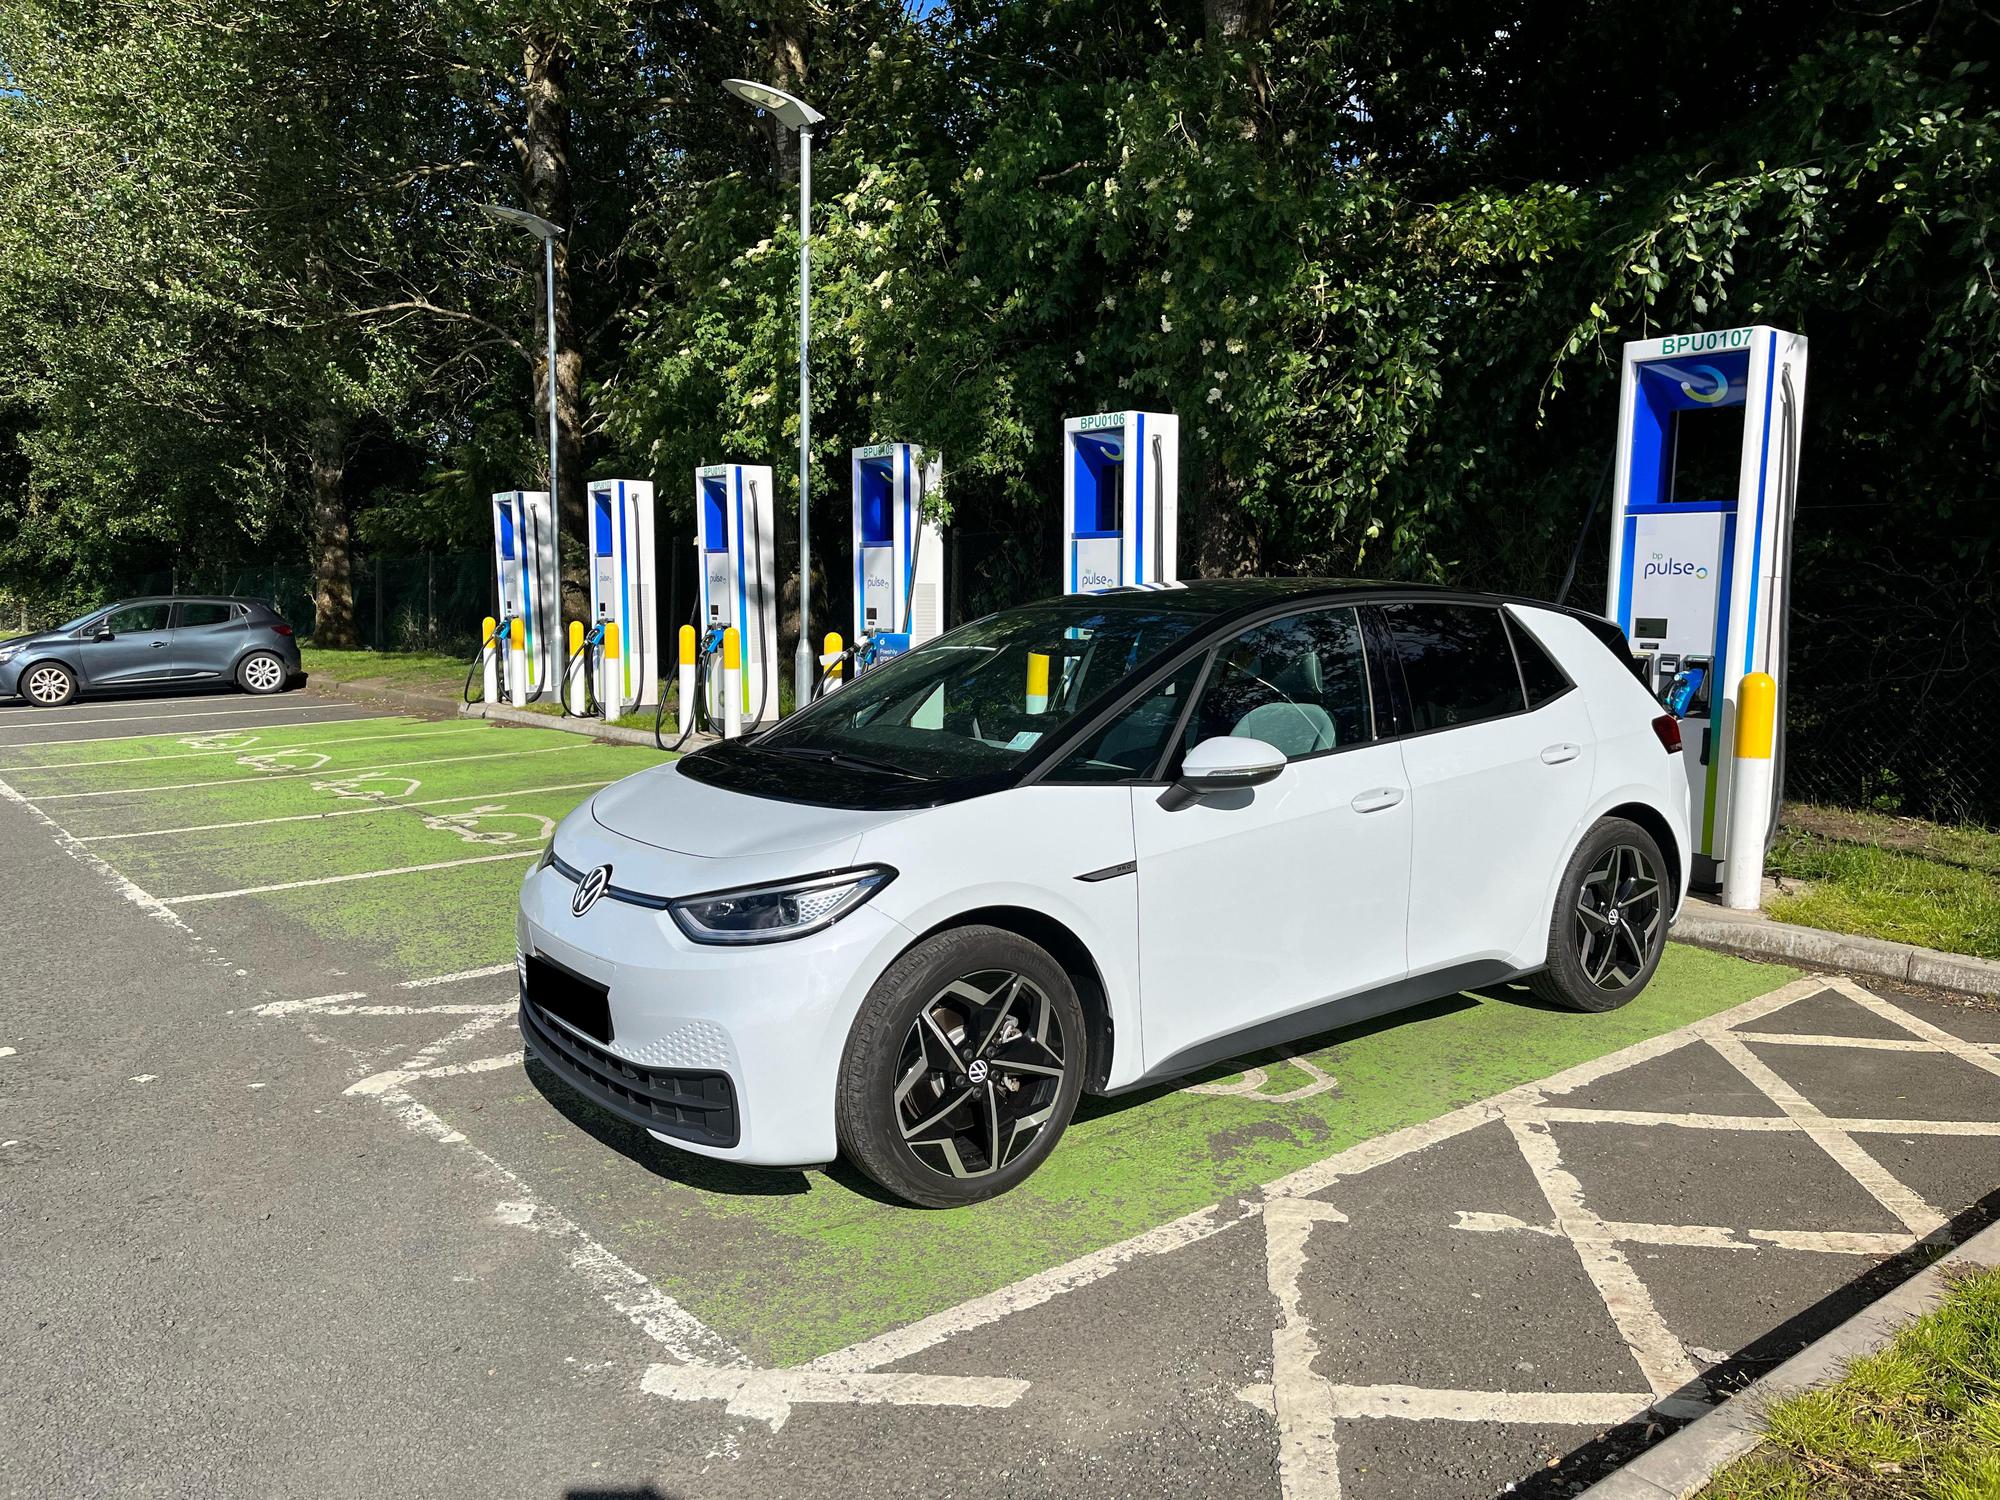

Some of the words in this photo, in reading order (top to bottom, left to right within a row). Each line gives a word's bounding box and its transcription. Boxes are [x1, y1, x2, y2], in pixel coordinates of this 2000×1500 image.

[1663, 329, 1753, 355] BPU0107
[1080, 413, 1125, 429] BPU0106
[1652, 552, 1664, 560] bp
[1644, 557, 1695, 580] pulse
[867, 576, 885, 589] pulse
[1082, 572, 1107, 588] pulse
